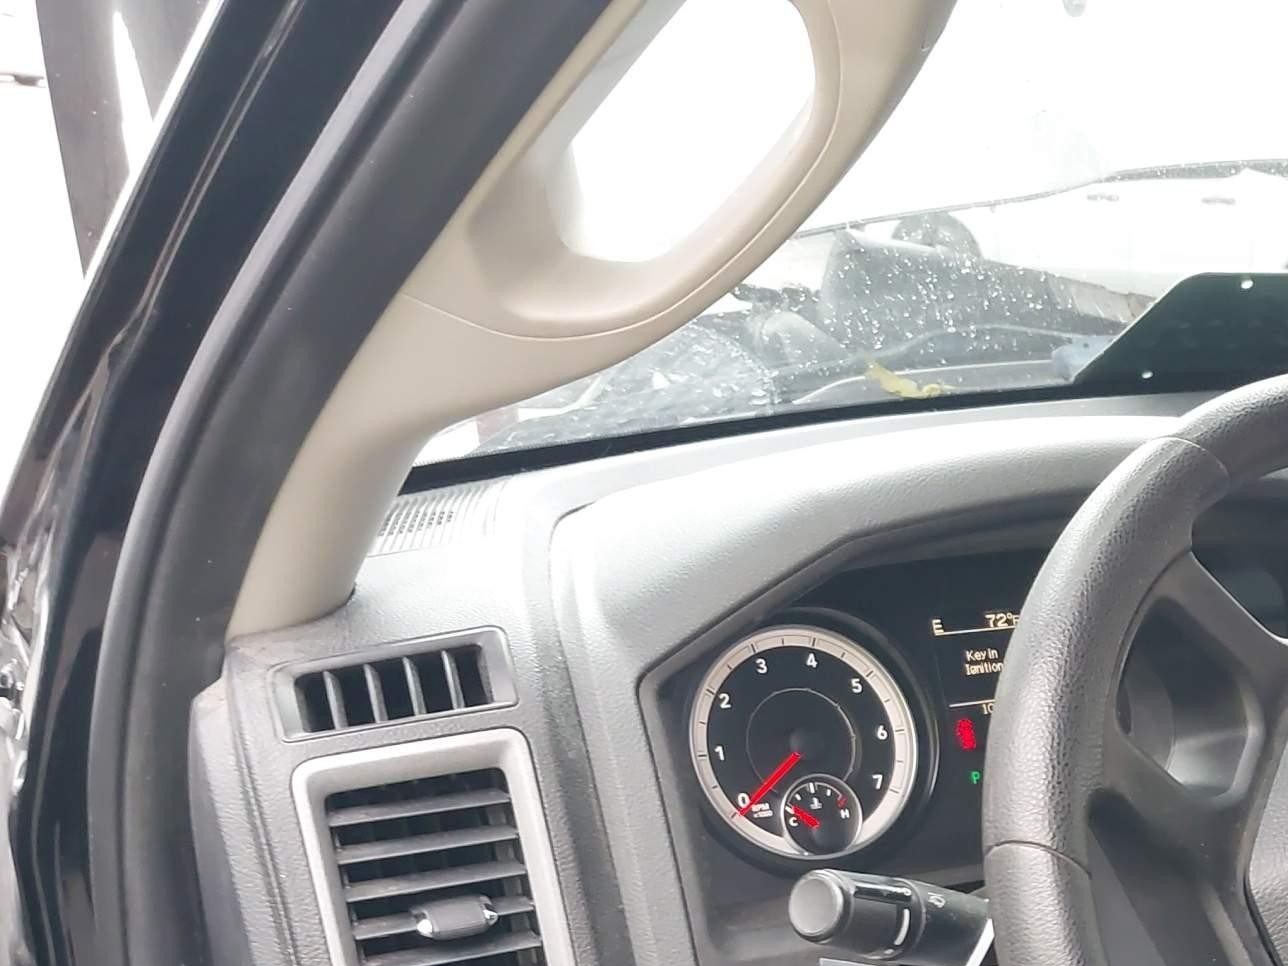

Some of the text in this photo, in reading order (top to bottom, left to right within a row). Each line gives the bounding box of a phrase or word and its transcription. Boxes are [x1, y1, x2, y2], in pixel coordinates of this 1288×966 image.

[932, 619, 945, 635] E
[805, 653, 818, 669] 4
[965, 650, 987, 661] Key
[755, 658, 768, 674] 3
[965, 662, 1004, 676] Ignition
[851, 679, 863, 694] 5
[718, 694, 731, 709] 2
[876, 726, 888, 740] 6
[714, 746, 725, 761] 1
[872, 774, 884, 790] 7
[971, 770, 981, 785] P
[737, 792, 751, 809] 0
[840, 808, 850, 820] H
[788, 817, 799, 827] C
